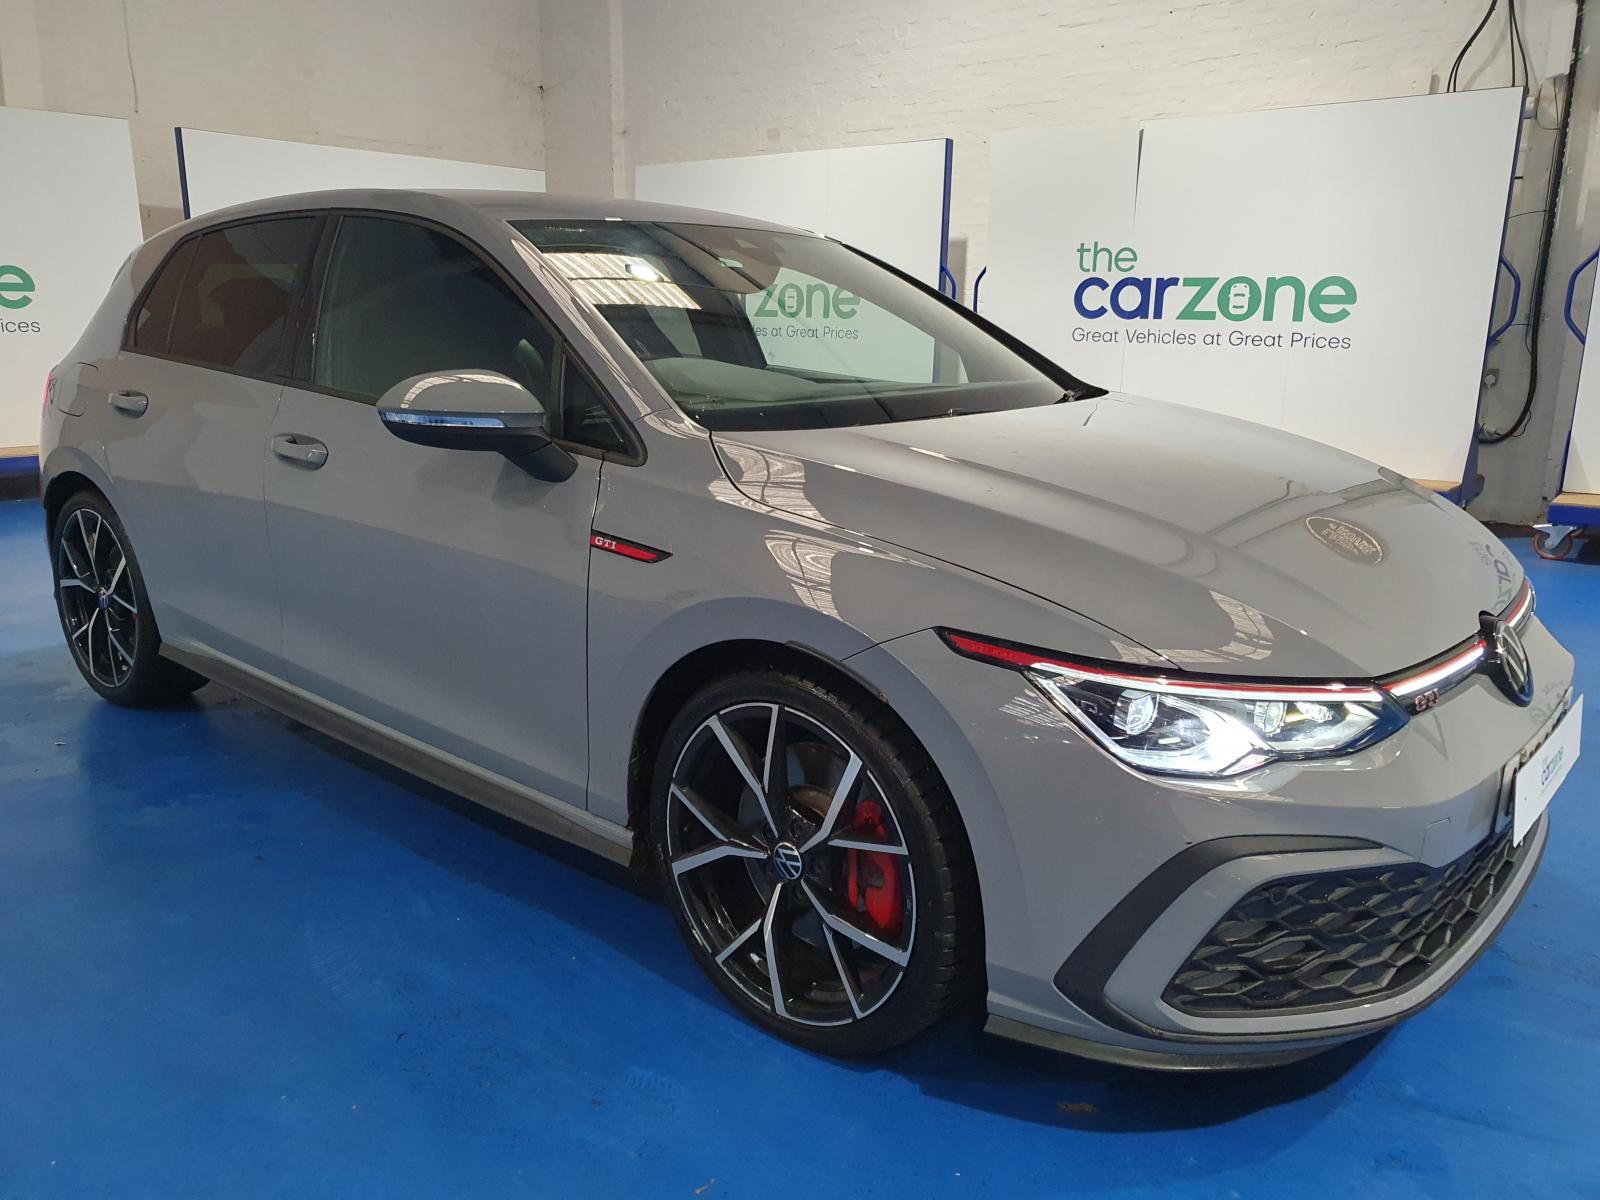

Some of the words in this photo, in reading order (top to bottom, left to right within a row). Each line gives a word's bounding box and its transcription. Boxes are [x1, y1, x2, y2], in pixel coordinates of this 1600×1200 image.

[1077, 241, 1138, 272] the
[1074, 275, 1357, 323] carzone
[771, 327, 782, 338] at
[786, 325, 820, 339] Great
[823, 326, 859, 340] Prices
[1072, 327, 1119, 342] Great
[1126, 328, 1197, 344] Vehicles
[1203, 332, 1222, 346] at
[1229, 330, 1283, 347] Great
[1290, 332, 1352, 349] Prices
[595, 536, 617, 550] GTI
